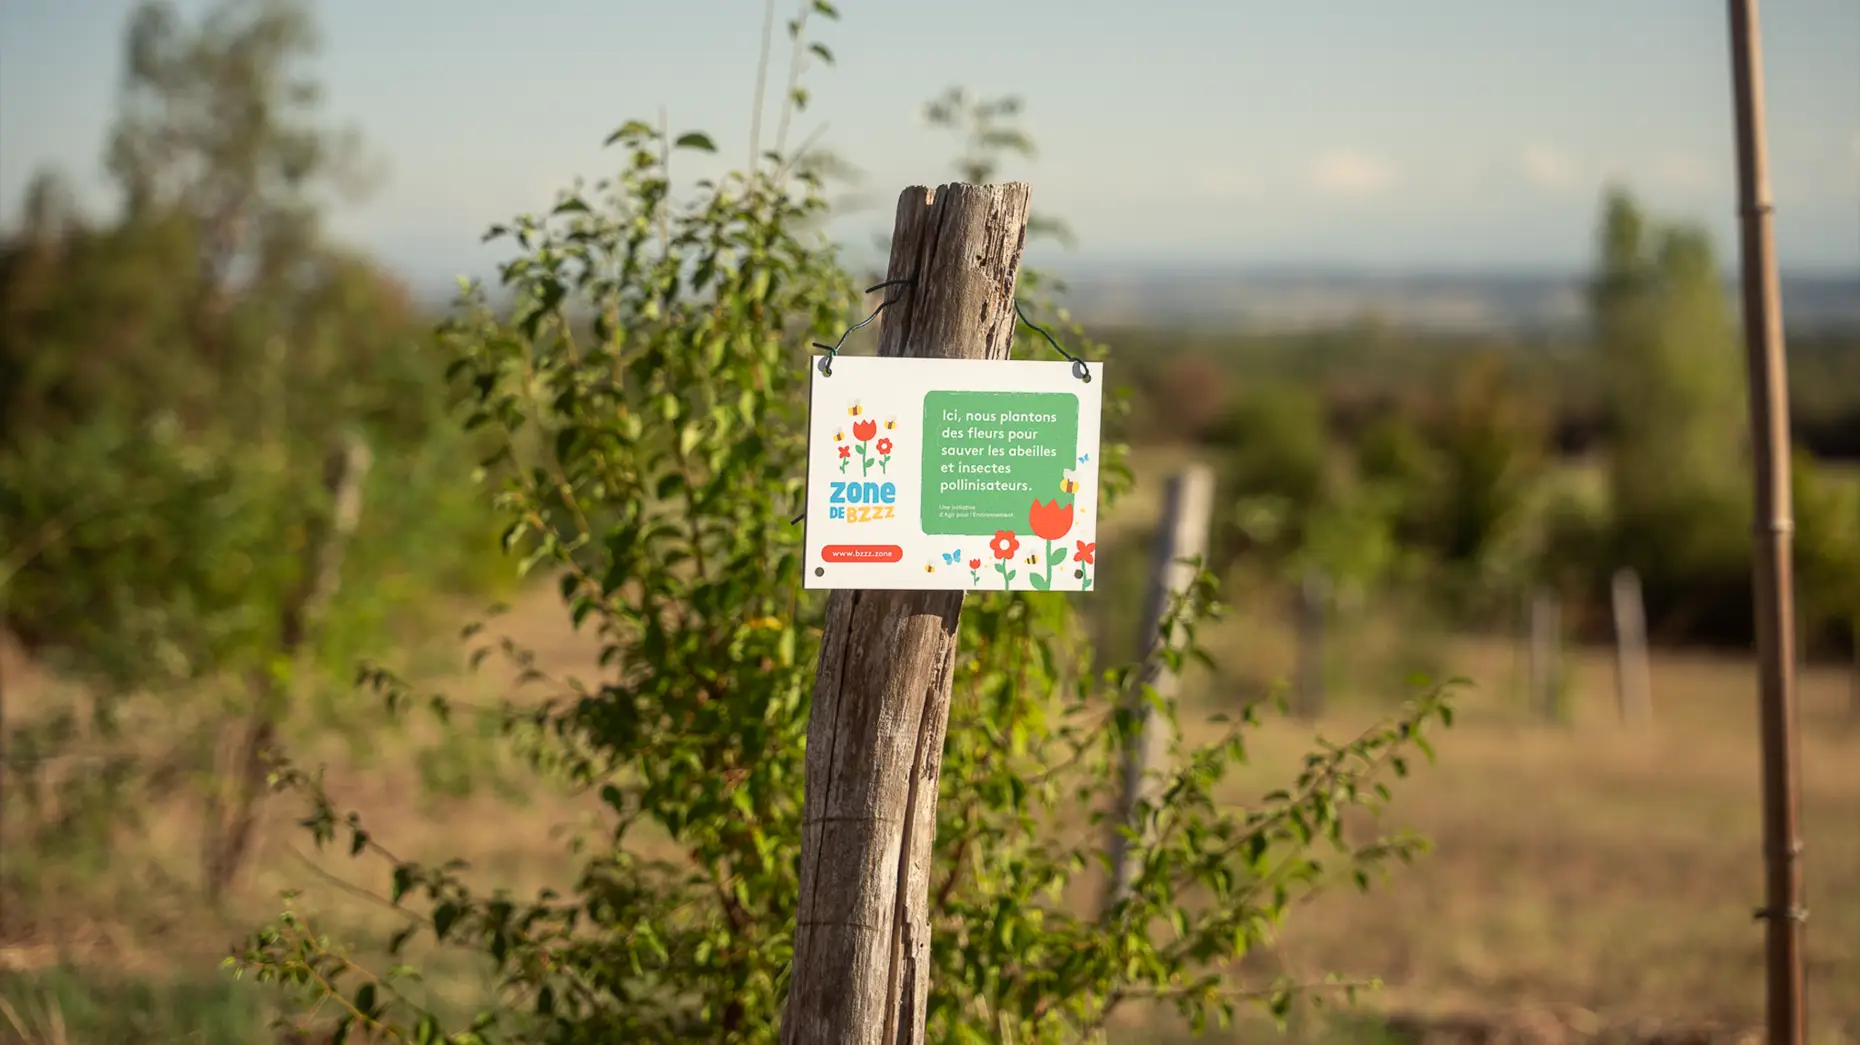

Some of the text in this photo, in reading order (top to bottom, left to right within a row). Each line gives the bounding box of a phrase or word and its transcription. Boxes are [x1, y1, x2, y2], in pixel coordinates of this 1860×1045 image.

[943, 409, 1057, 424] Ici, nous plantons
[942, 427, 1038, 442] des fleurs pour
[941, 445, 1056, 456] sauver les abeilles
[941, 462, 1011, 474] et insectes
[940, 479, 1032, 493] pollinisateurs.
[830, 507, 844, 518] DE
